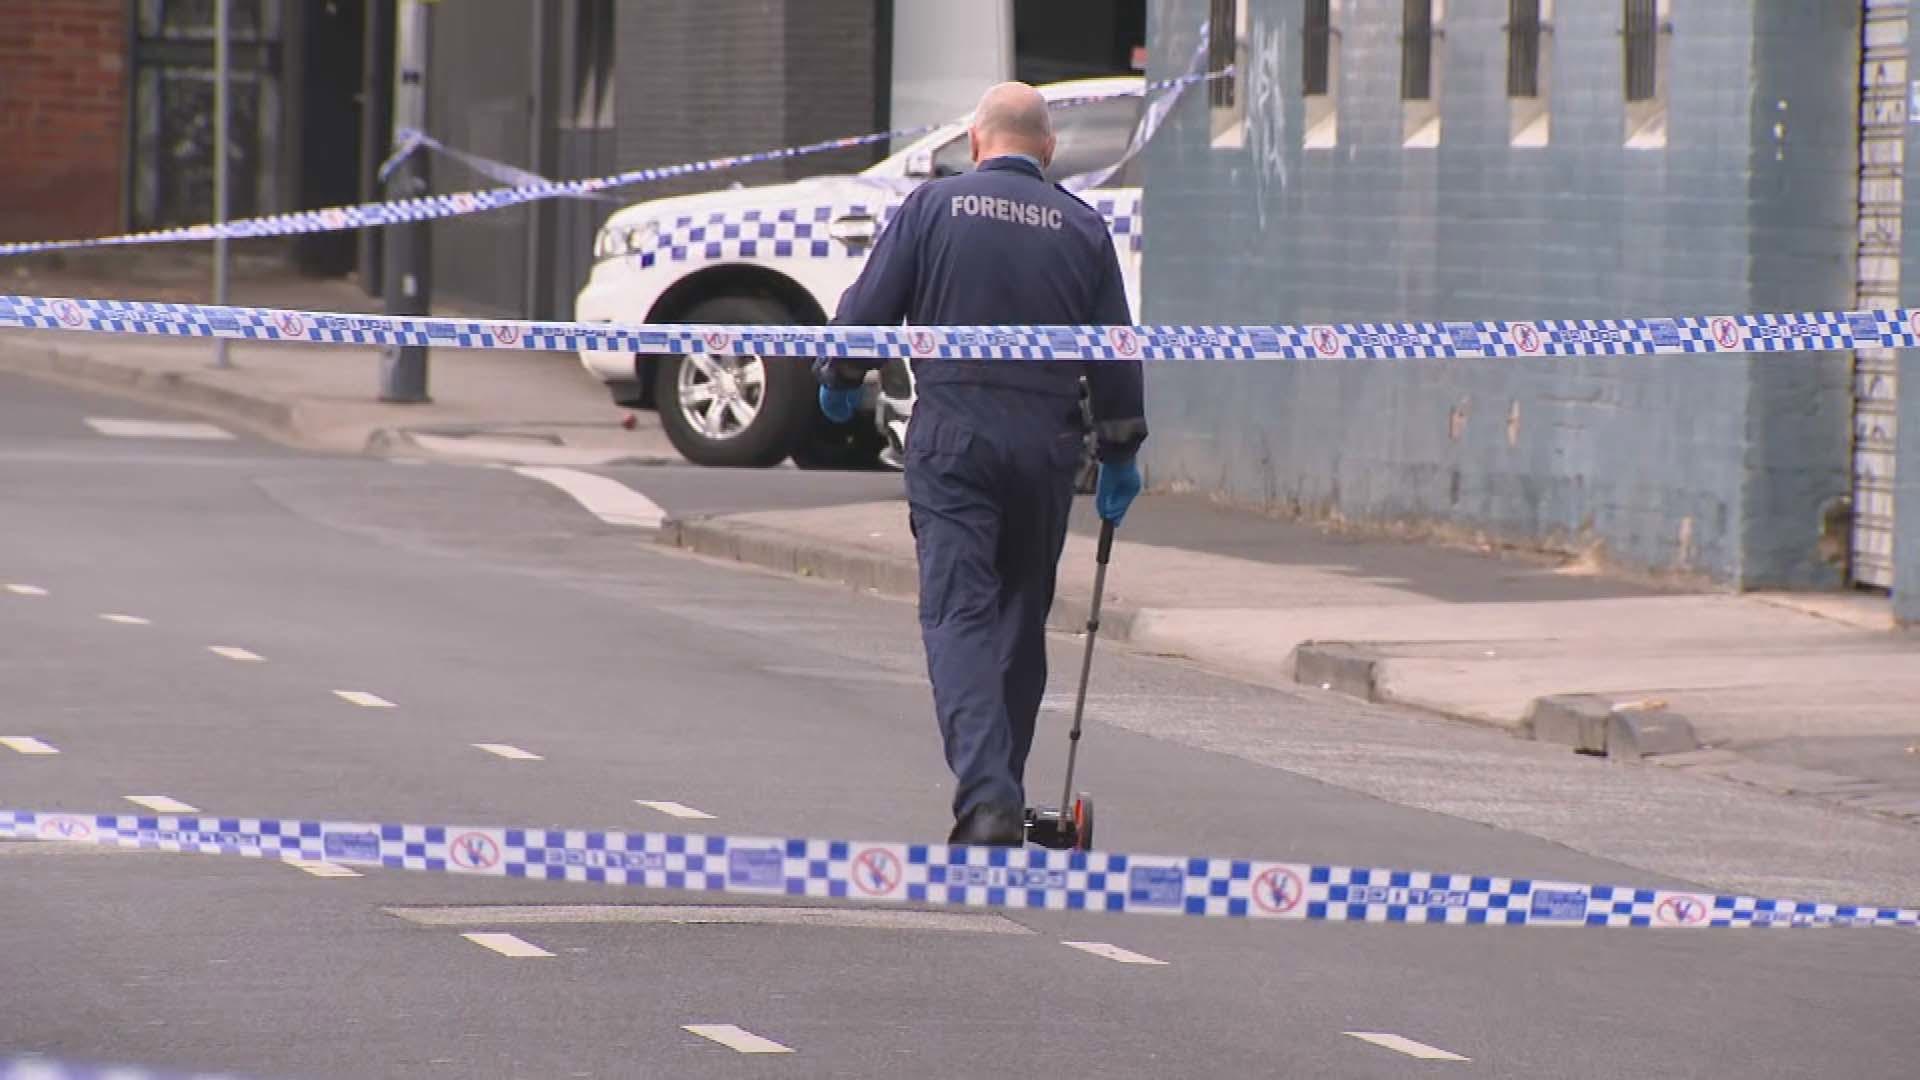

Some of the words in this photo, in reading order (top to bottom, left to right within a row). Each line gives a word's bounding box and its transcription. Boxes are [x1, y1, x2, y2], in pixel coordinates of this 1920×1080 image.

[951, 195, 1063, 230] FORENSIC
[545, 848, 666, 871] POLICE
[947, 864, 1067, 889] POLICE
[1349, 884, 1469, 909] POLICE
